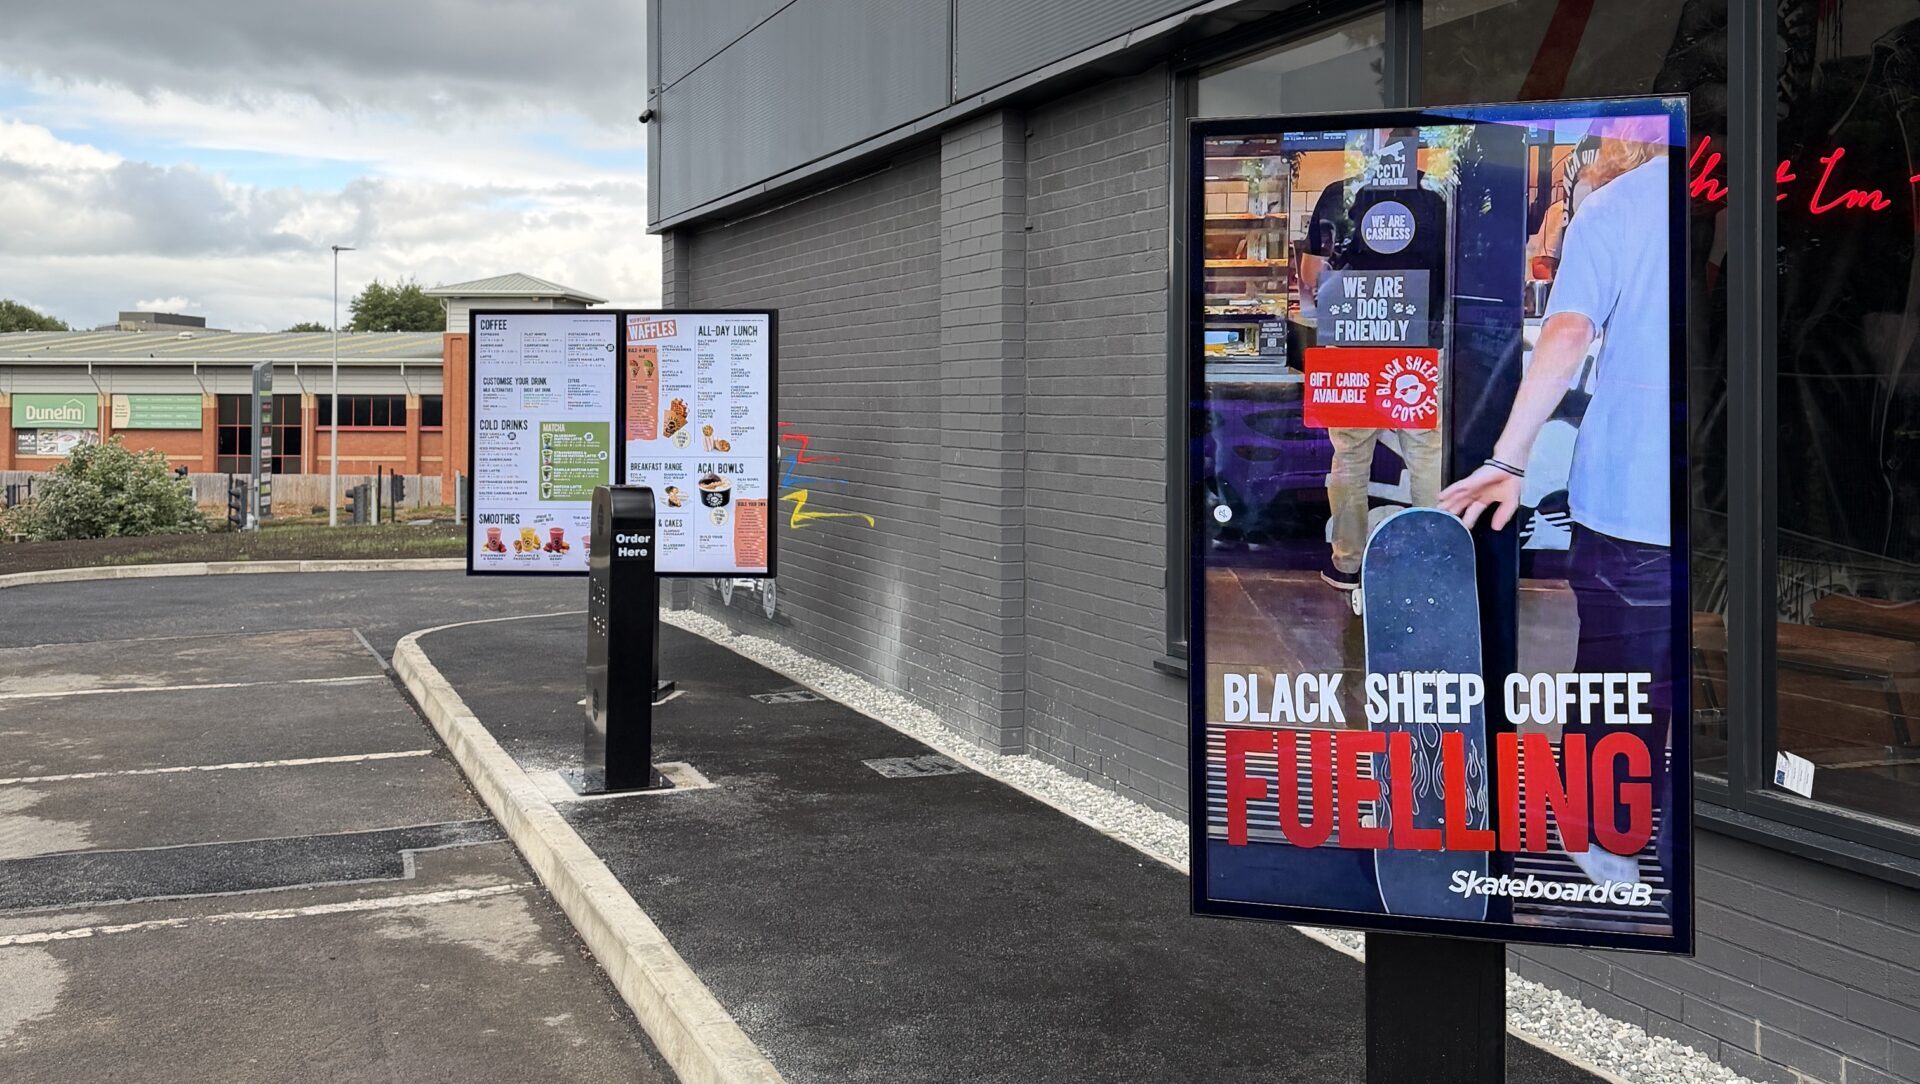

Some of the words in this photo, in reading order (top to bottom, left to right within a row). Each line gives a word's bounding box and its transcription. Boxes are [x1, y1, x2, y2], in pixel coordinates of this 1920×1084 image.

[1376, 164, 1405, 178] CCTV
[1380, 178, 1408, 186] OPERATION
[1371, 215, 1386, 227] WE
[1388, 215, 1406, 228] ARE
[1365, 228, 1410, 240] CASHLESS
[1342, 277, 1367, 298] WE
[1373, 277, 1404, 298] ARE
[1357, 298, 1388, 319] DOG
[480, 319, 507, 330] COFFEE
[628, 320, 675, 340] WAFFLES
[1335, 320, 1410, 341] FRIENDLY
[698, 326, 730, 336] ALL-DAY
[733, 326, 758, 336] LUNCH
[483, 377, 512, 385] CUSTOMISE
[515, 377, 529, 385] YOUR
[531, 377, 547, 385] DRINK
[1310, 372, 1332, 387] GIFT
[1336, 372, 1370, 387] CARDS
[1376, 358, 1404, 396] BLACK
[1312, 389, 1366, 403] AVAILABLE
[26, 405, 82, 420] Dunelm
[480, 420, 498, 430] COLD
[501, 420, 528, 430] DRINKS
[543, 424, 565, 432] MATCHA
[630, 463, 662, 471] BREAKFAST
[664, 463, 683, 471] RANGE
[718, 463, 744, 474] BOWLS
[479, 514, 520, 524] SMOOTHIES
[658, 519, 662, 528] &
[664, 519, 683, 528] CAKES
[615, 534, 651, 544] Order
[618, 547, 648, 557] Here
[1224, 673, 1345, 723] BLACK
[1364, 672, 1485, 724] SHEEP
[1504, 672, 1652, 725] COFFEE
[1225, 731, 1652, 855] FUELLING
[1448, 869, 1653, 906] SkateboardGB
